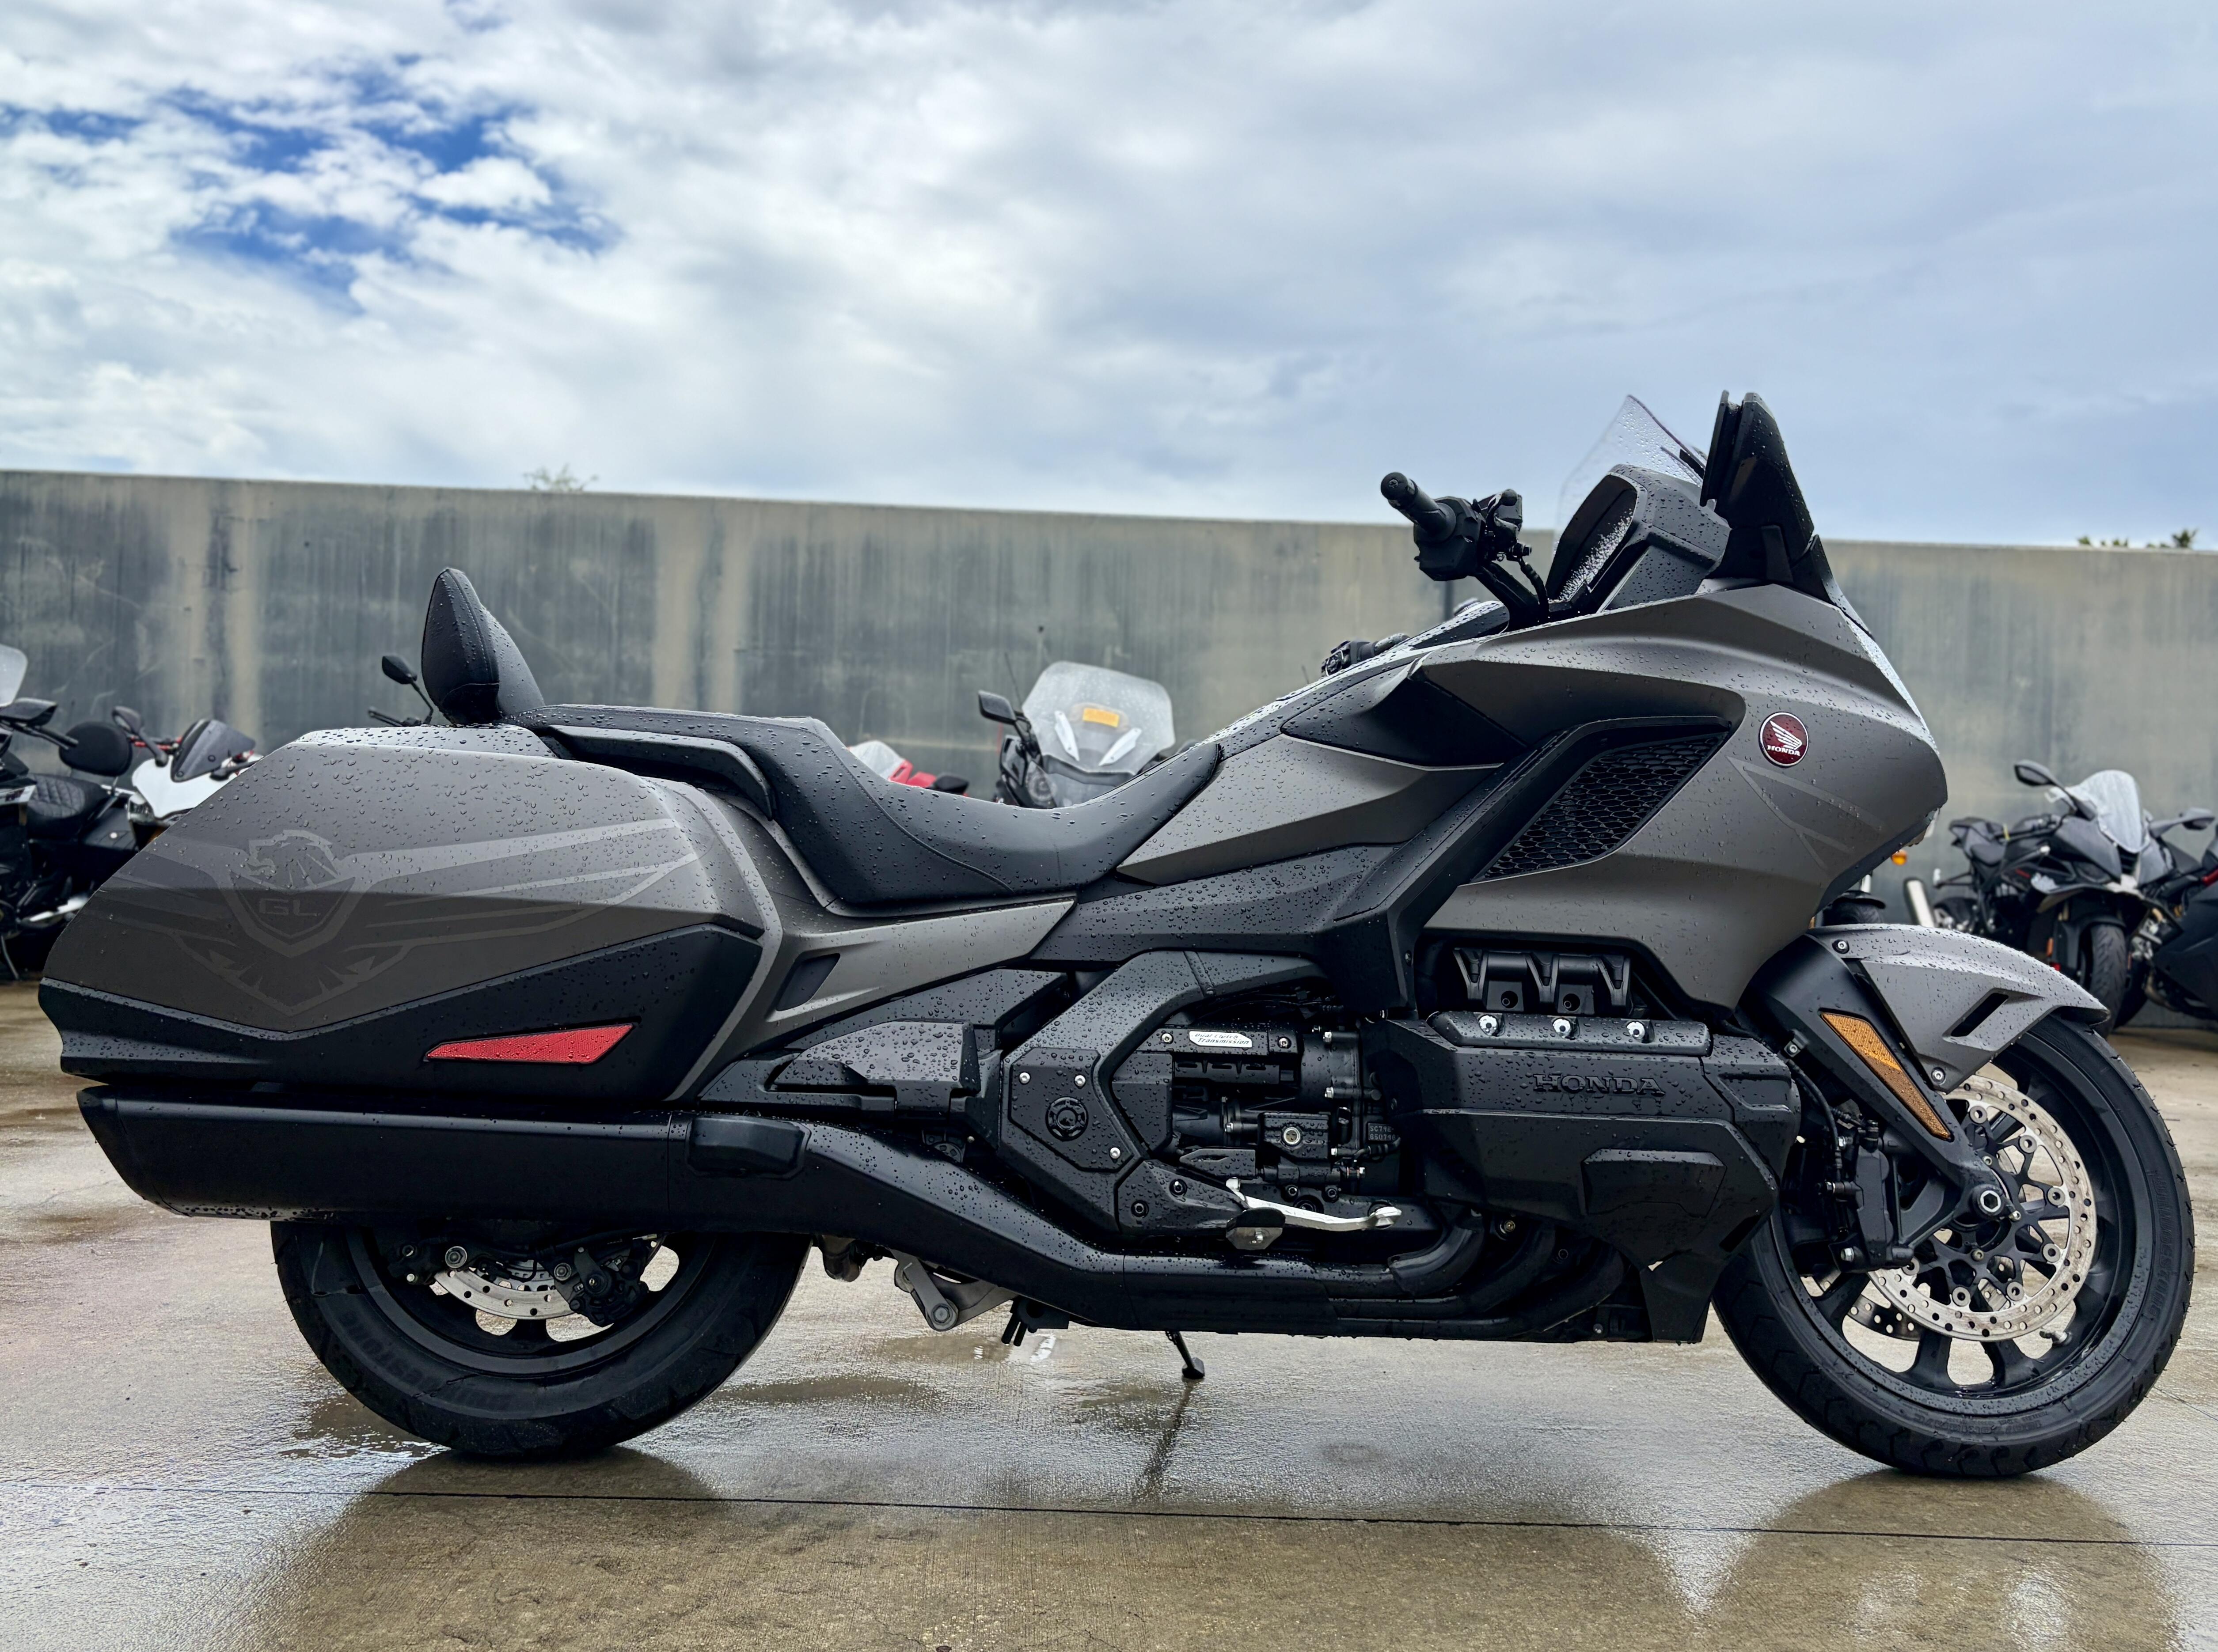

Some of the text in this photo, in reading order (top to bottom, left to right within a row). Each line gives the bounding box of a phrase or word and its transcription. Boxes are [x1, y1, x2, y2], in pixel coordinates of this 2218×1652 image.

[1767, 745, 1800, 756] HONDA
[259, 898, 321, 917] GL
[1533, 1074, 1666, 1097] HONDA
